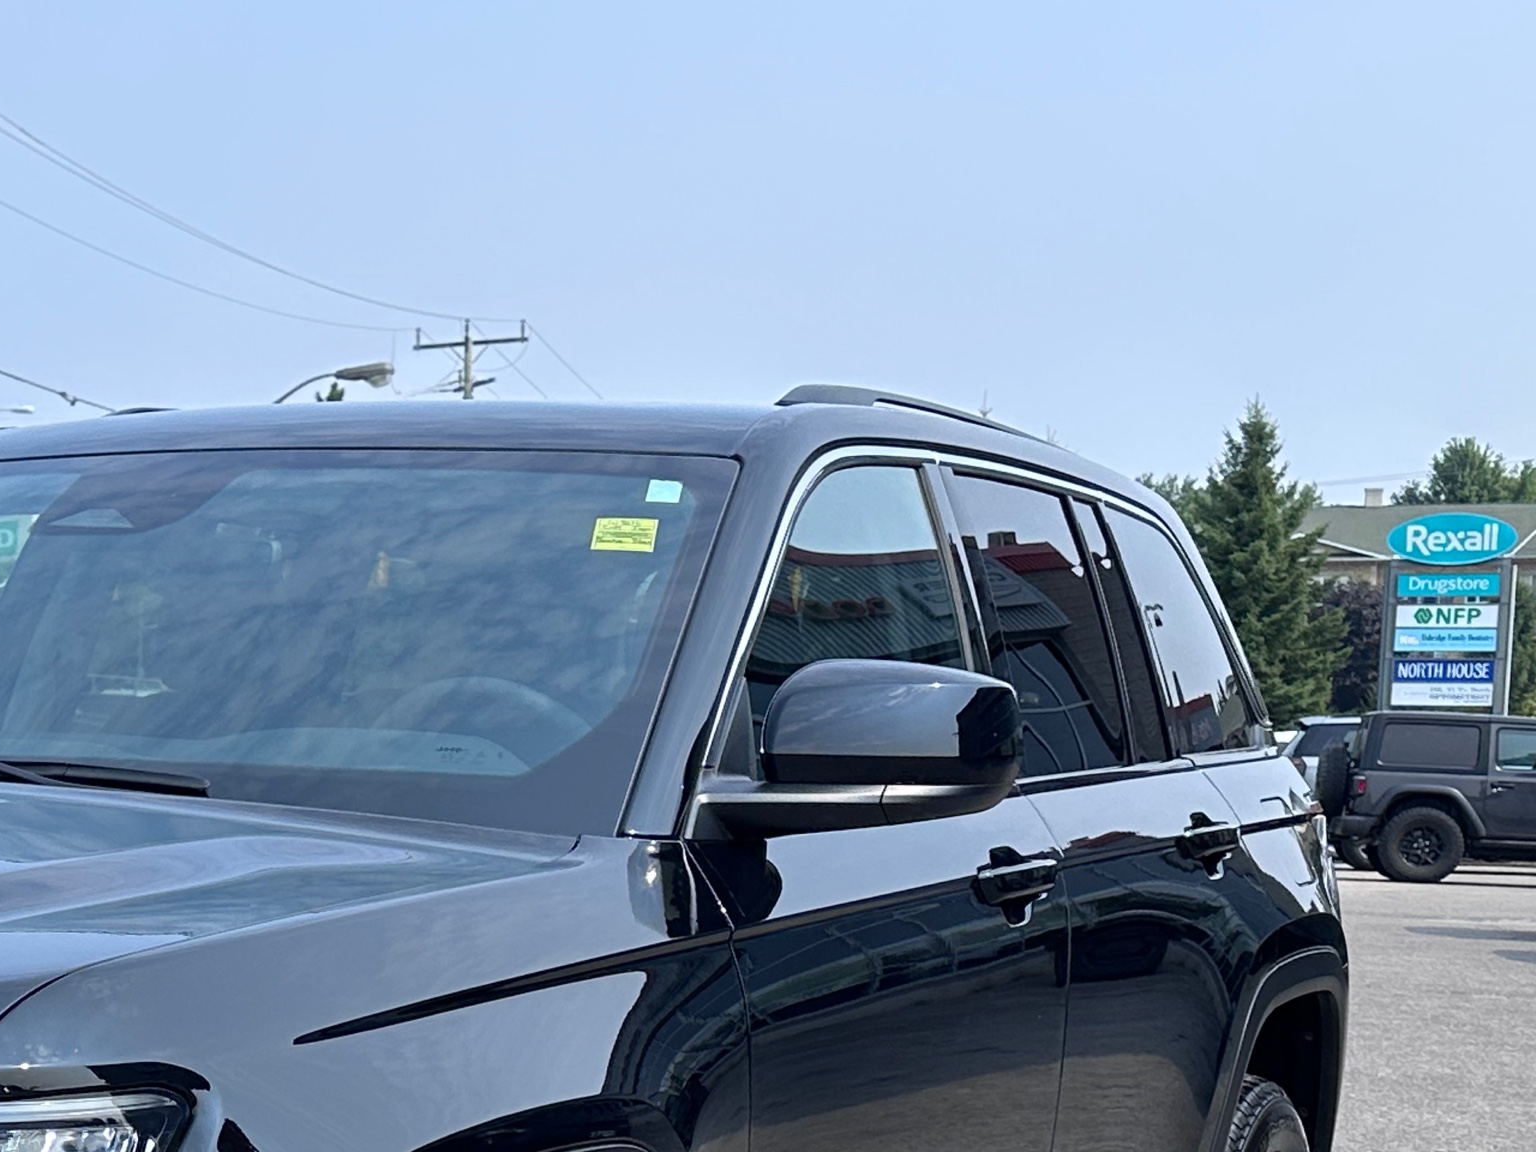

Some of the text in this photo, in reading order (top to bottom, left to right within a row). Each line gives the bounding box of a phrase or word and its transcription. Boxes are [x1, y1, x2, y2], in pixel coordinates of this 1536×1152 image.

[1405, 522, 1499, 556] Rexall
[1408, 576, 1490, 594] Drugstore
[1435, 607, 1482, 625] NFP
[1397, 662, 1491, 679] NORTH HOUSE
